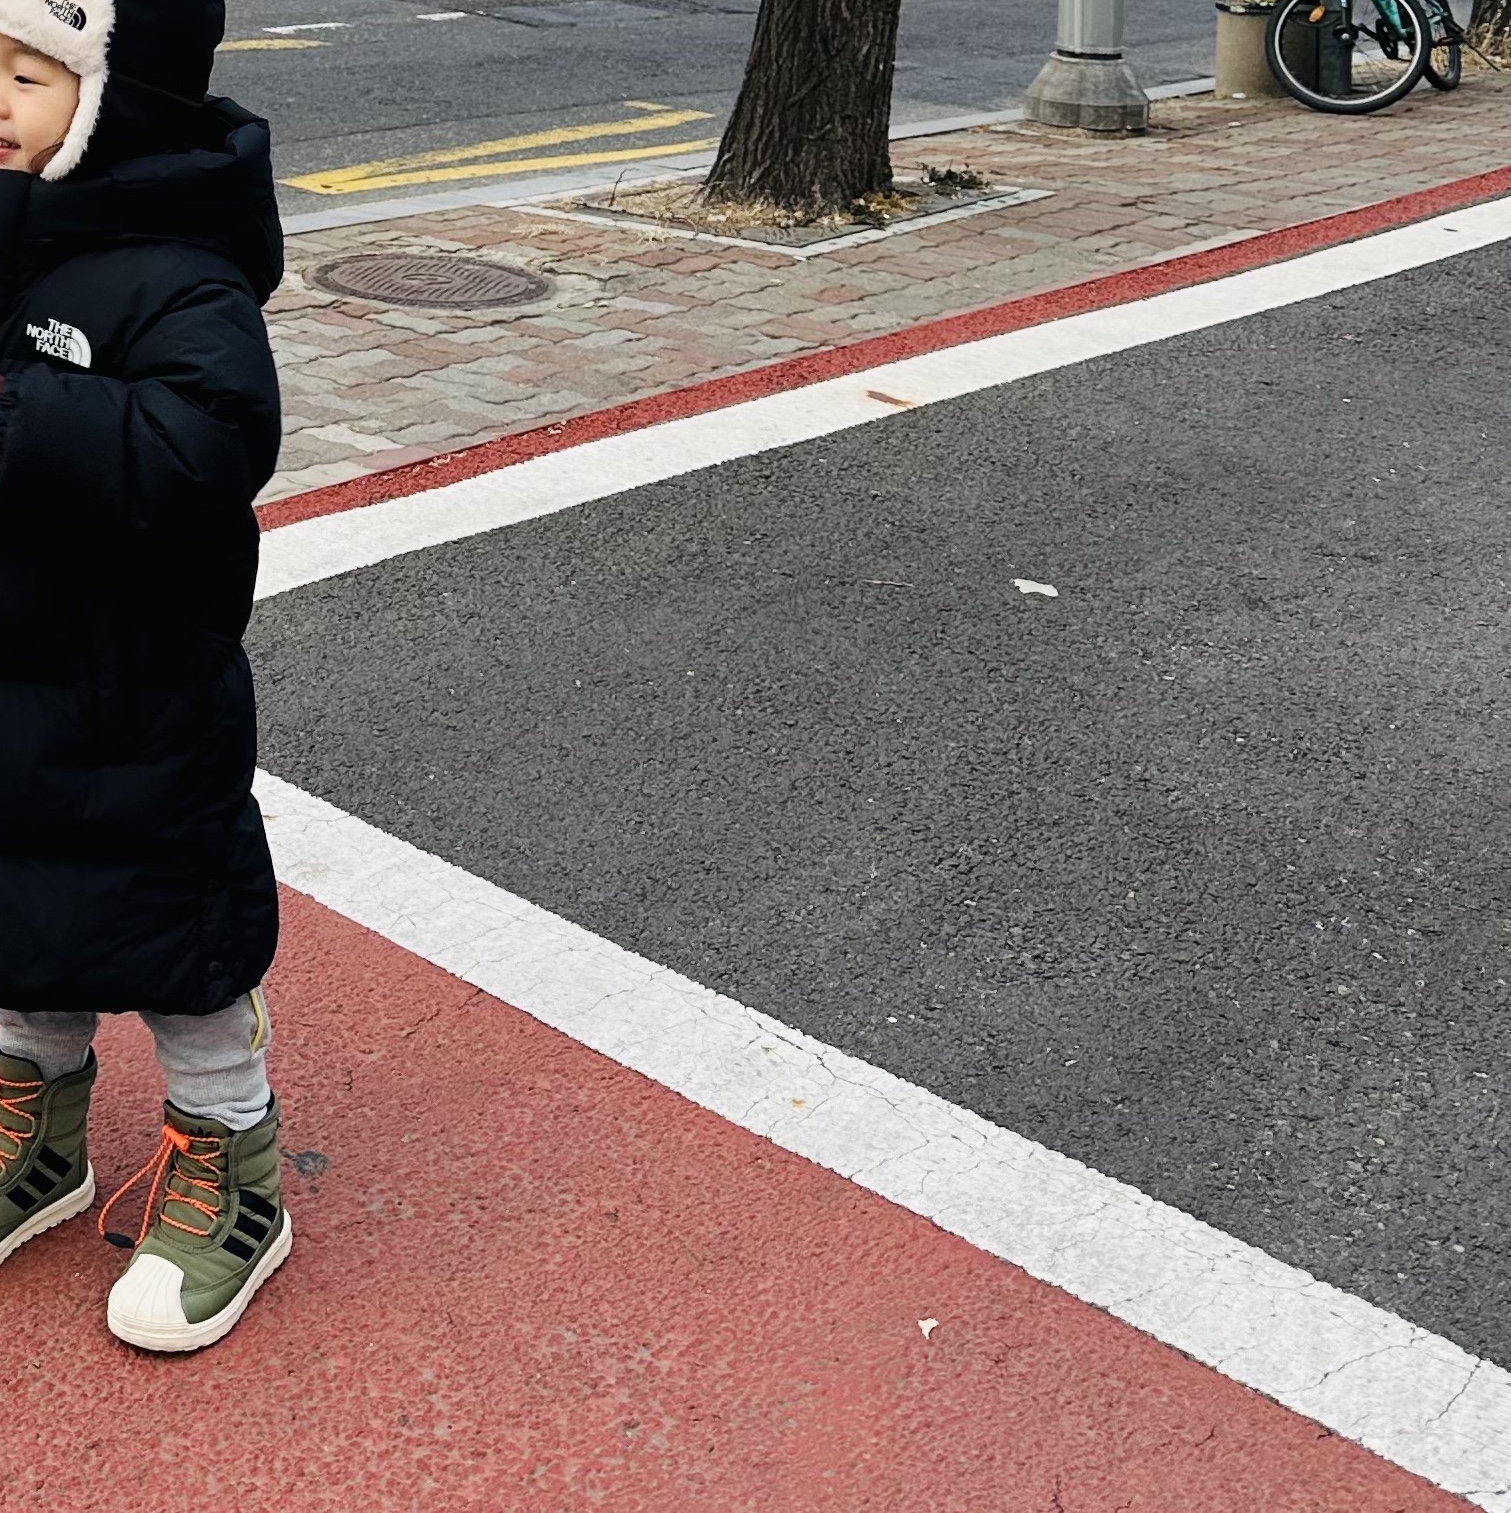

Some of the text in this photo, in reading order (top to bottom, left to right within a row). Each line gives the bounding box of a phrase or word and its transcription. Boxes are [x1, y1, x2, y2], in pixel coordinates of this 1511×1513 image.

[26, 323, 71, 348] NORTH
[48, 317, 73, 336] THE
[36, 339, 69, 360] FACE
